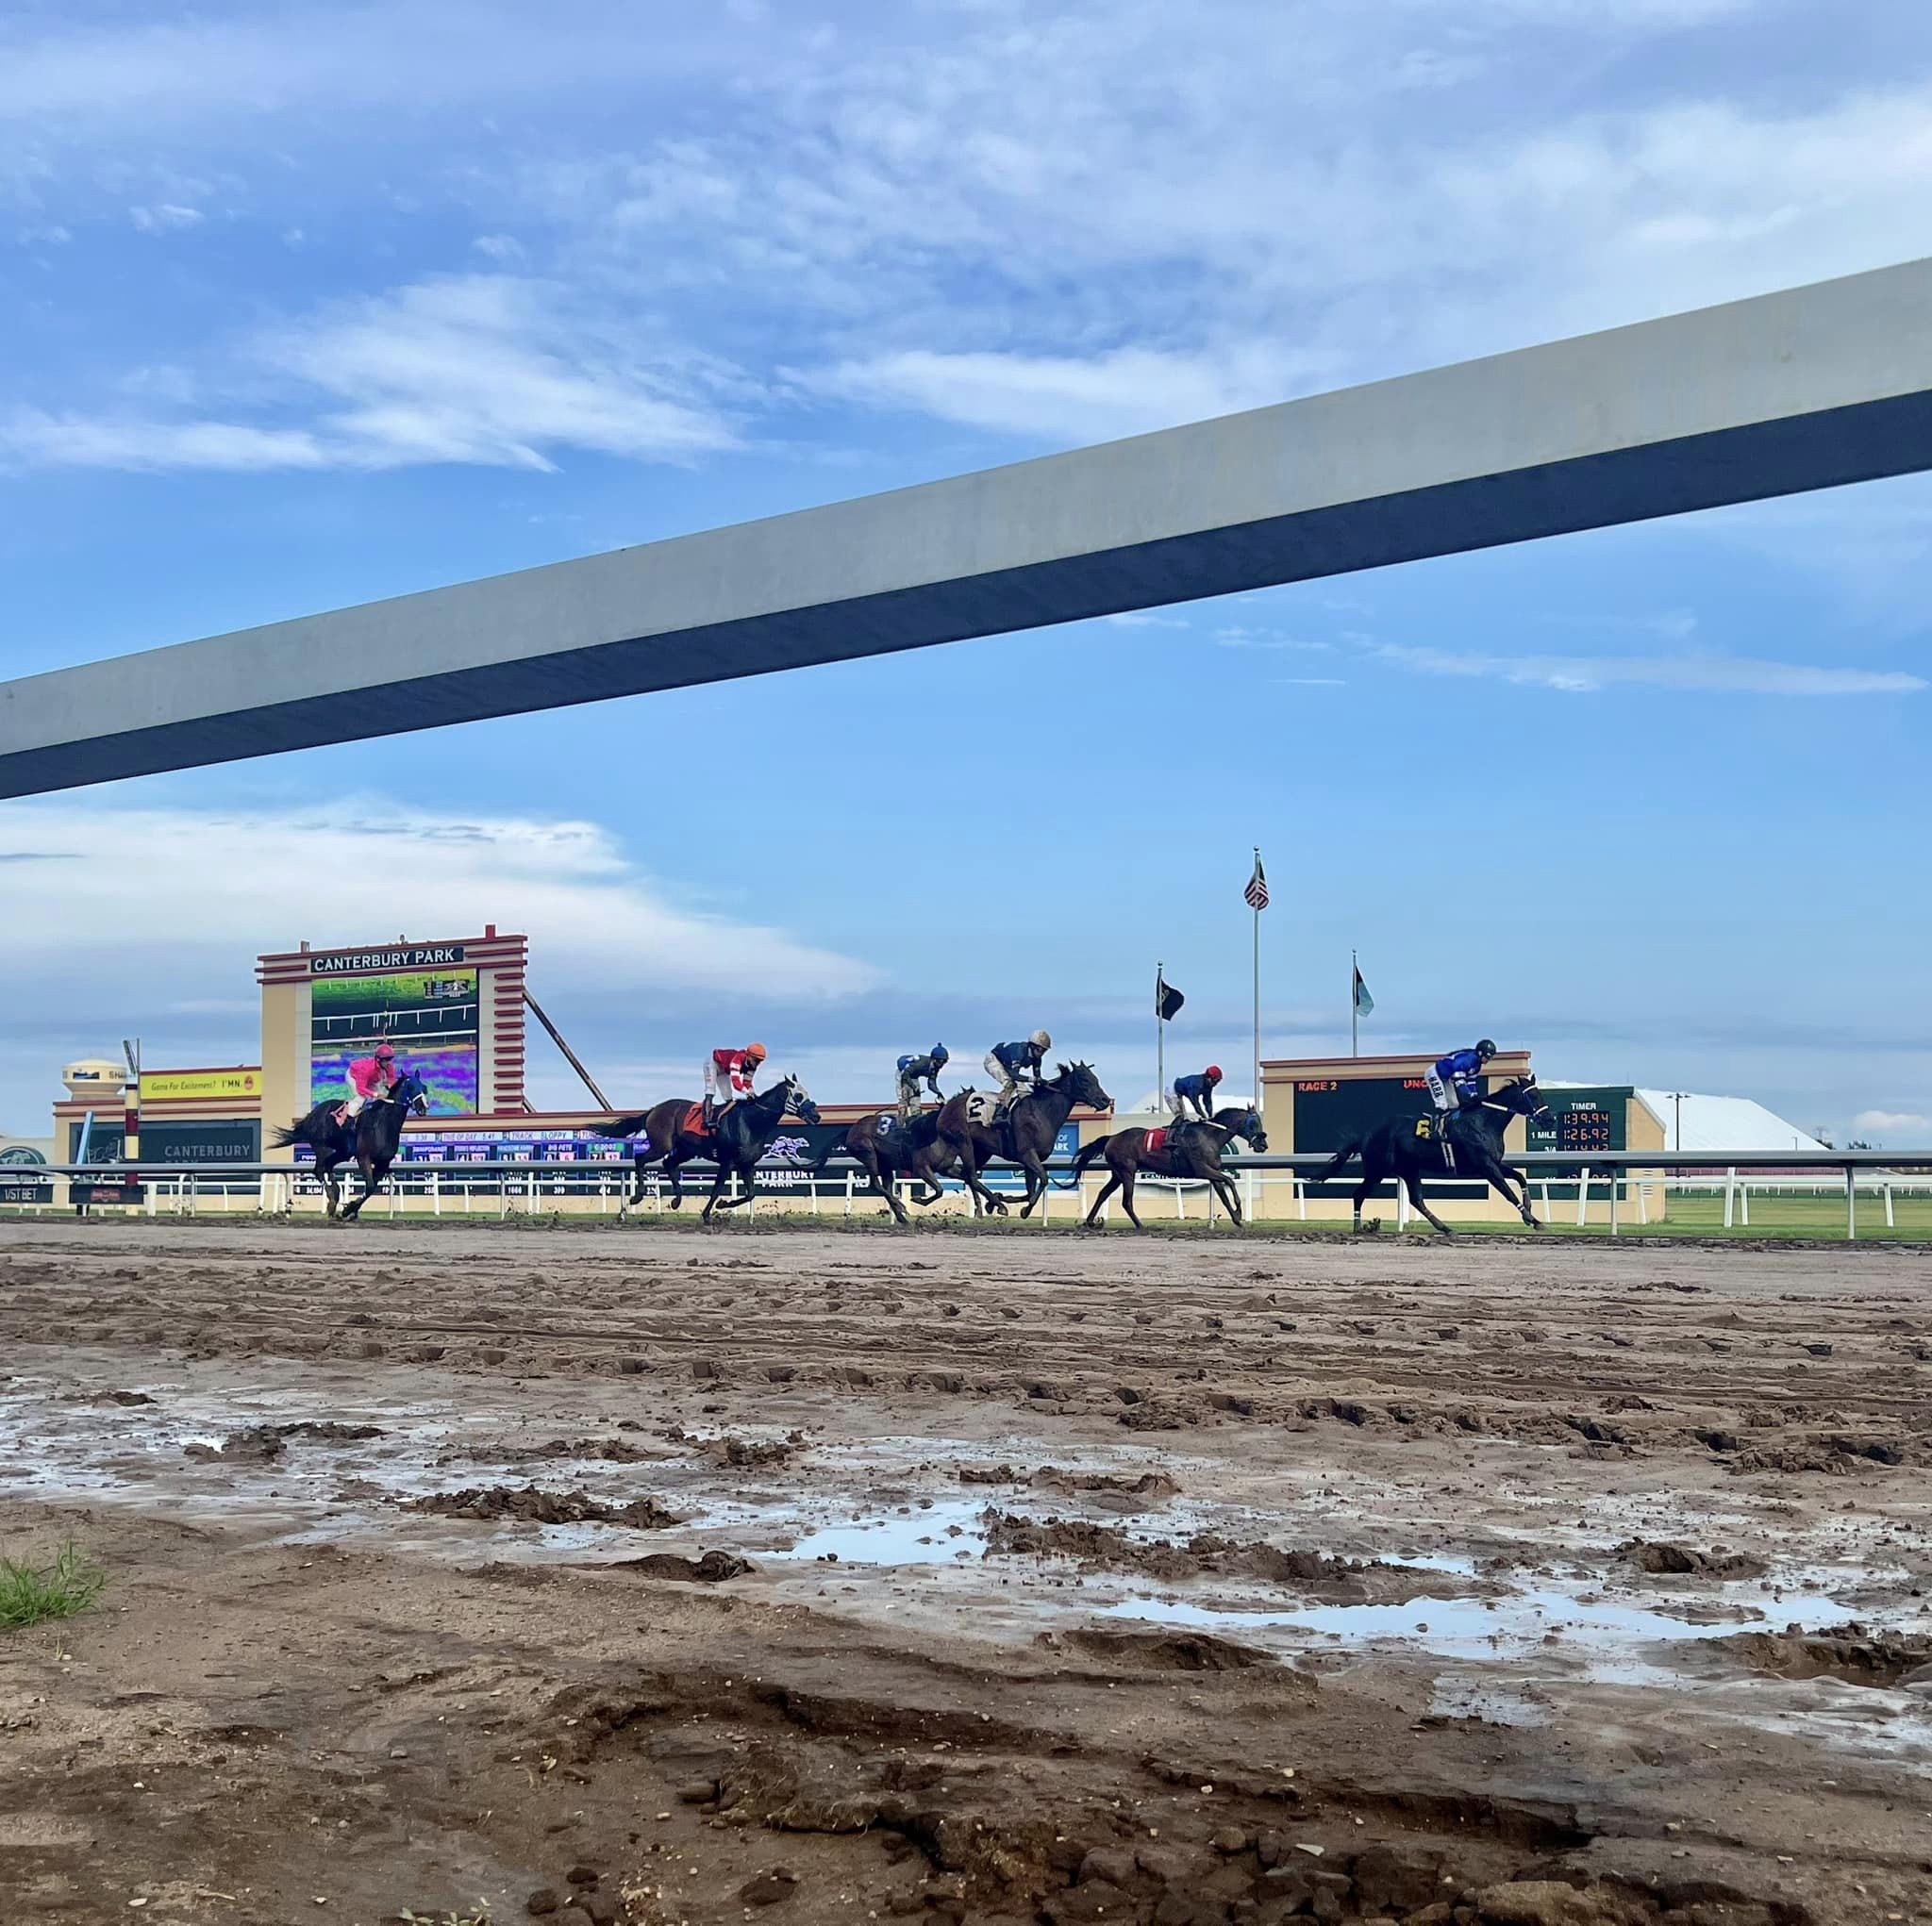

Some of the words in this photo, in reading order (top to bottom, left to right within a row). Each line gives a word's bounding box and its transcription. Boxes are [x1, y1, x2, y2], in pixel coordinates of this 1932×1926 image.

[314, 953, 409, 971] CANTERBURY
[415, 949, 455, 964] PARK
[1298, 1081, 1328, 1092] RACE
[1330, 1081, 1338, 1091] 2
[968, 1097, 985, 1118] 2
[877, 1116, 892, 1136] 3
[511, 1131, 534, 1140] TRACK
[1537, 1131, 1557, 1139] MILE
[1563, 1128, 1608, 1140] 1:26.92
[1146, 1132, 1155, 1152] 1
[164, 1144, 250, 1157] CANTERBURY
[754, 1171, 814, 1179] NTERBURY
[22, 1187, 38, 1201] BET
